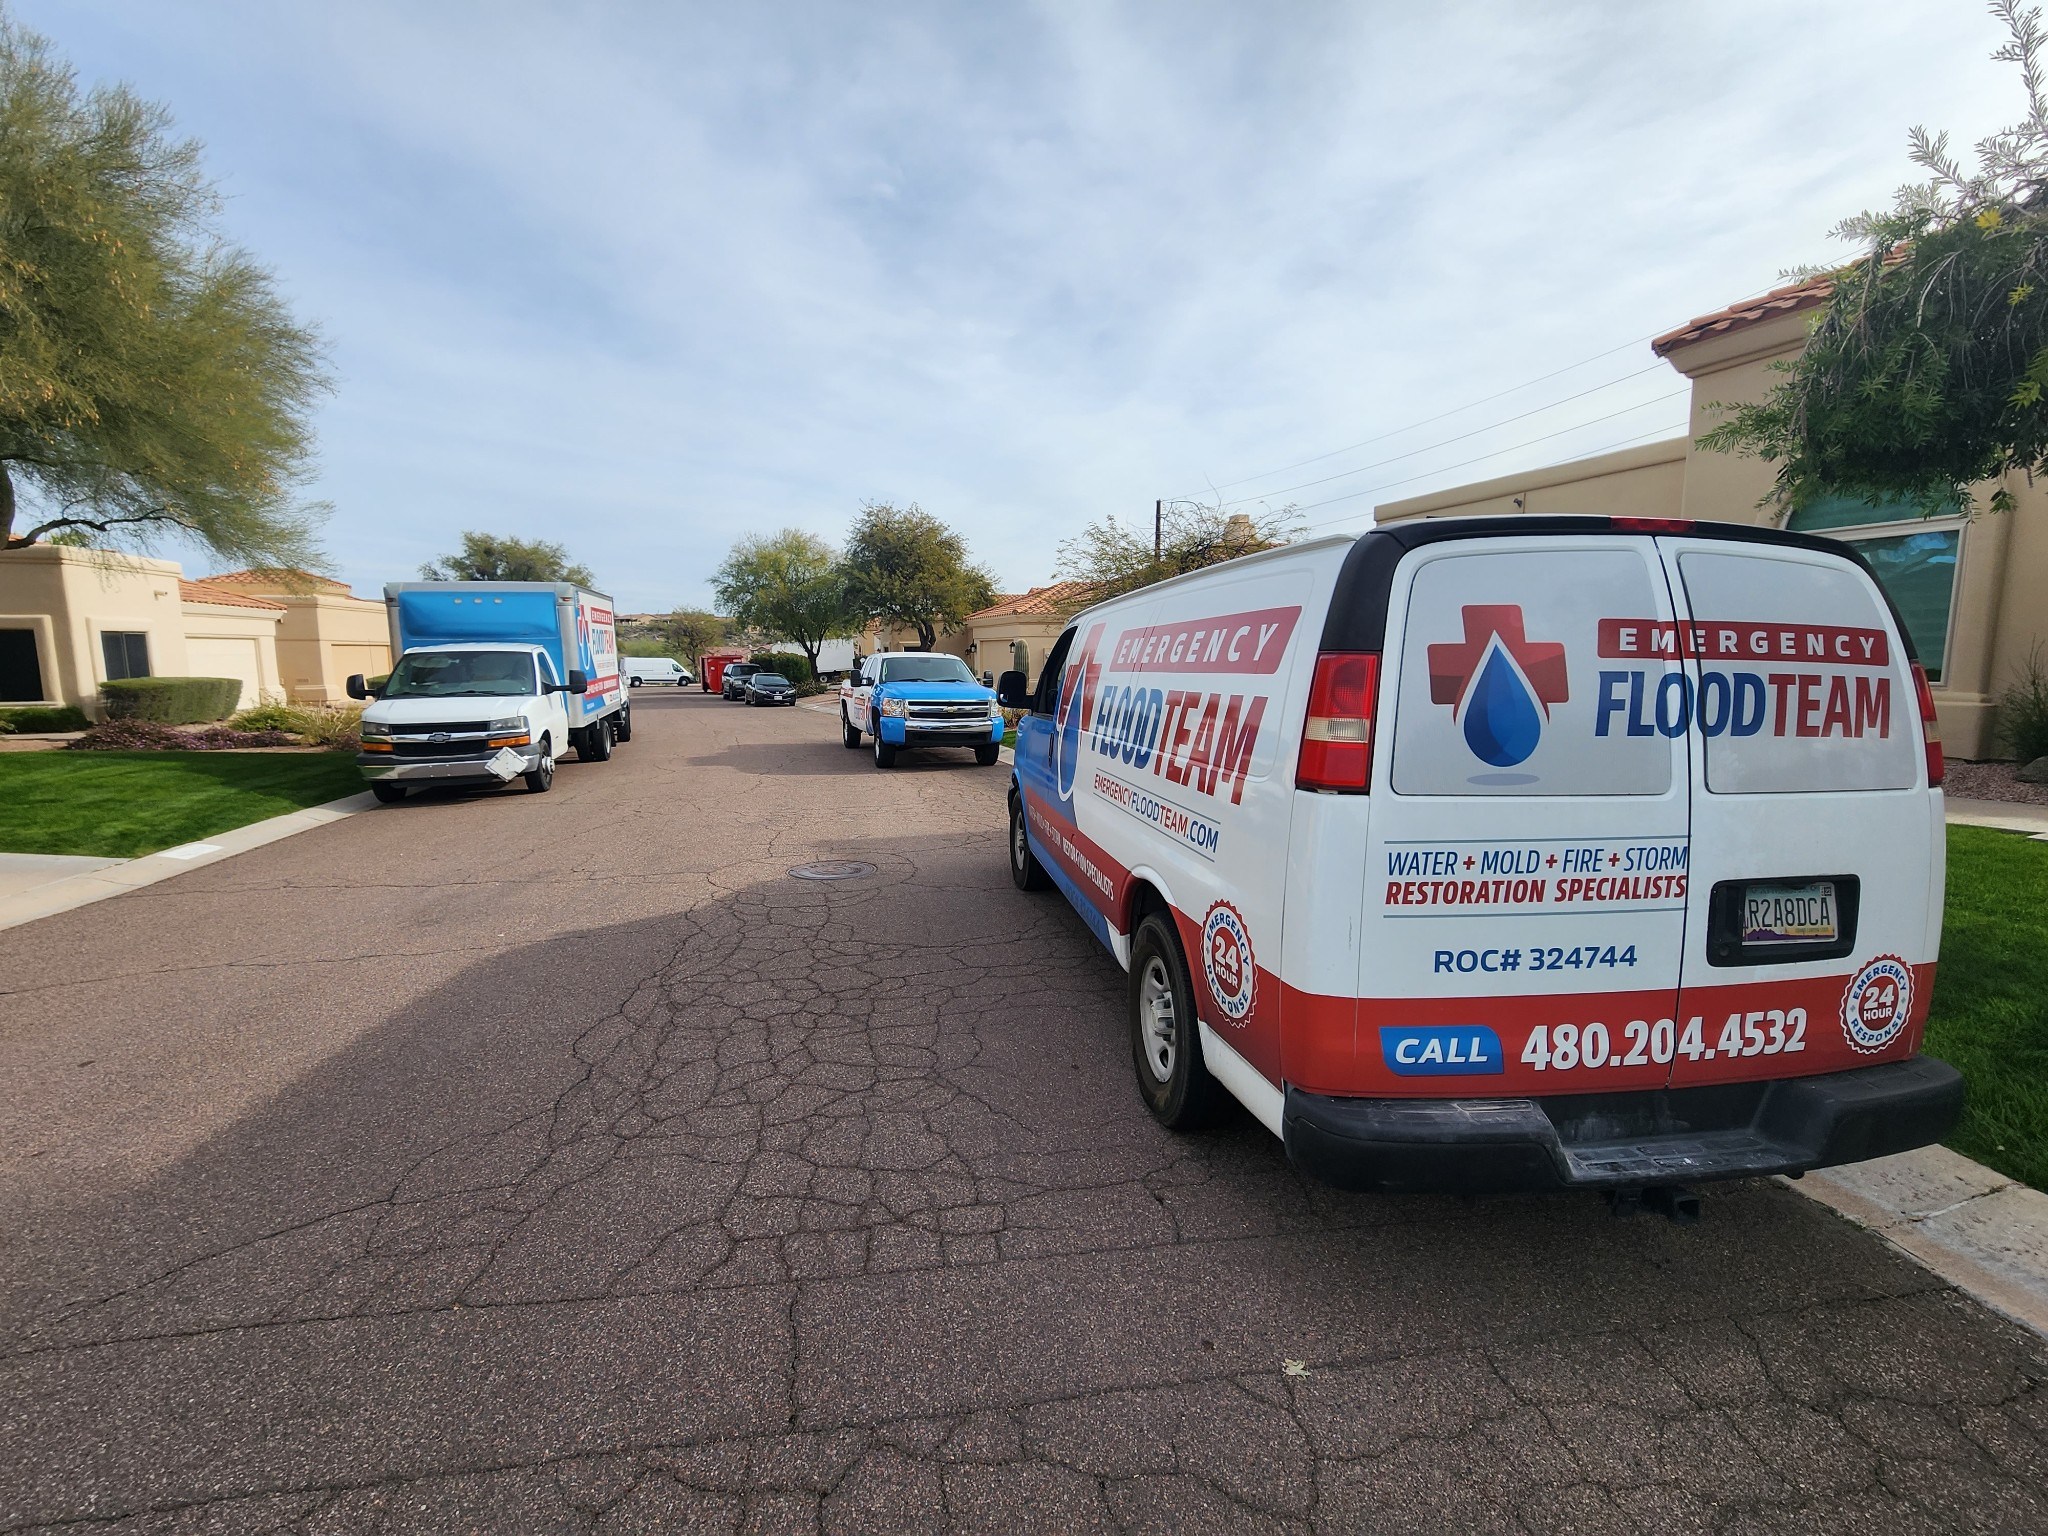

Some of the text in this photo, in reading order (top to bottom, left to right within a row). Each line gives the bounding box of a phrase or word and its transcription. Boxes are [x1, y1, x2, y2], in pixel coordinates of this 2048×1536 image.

[1117, 623, 1280, 664] EMERGENCY
[1618, 627, 1876, 659] EMERGENCY
[1595, 671, 1891, 739] FLOODTEAM
[1091, 685, 1269, 806] FLOODTEAM
[1094, 774, 1220, 853] EMERGENCYFLOODTEAM.COM
[1387, 851, 1459, 876] WATER
[1480, 849, 1541, 874] MOLD
[1562, 848, 1605, 872] FIRE
[1624, 846, 1689, 871] STORM
[1384, 874, 1688, 905] RESTORATION SPECIALISTS
[1748, 897, 1831, 928] R2A8DCA
[1206, 912, 1250, 966] EMERGENCY
[1215, 935, 1239, 974] 24
[1215, 962, 1239, 989] HOUR
[1434, 945, 1638, 973] ROC# 324744
[1206, 964, 1250, 1014] RESPONSE
[1852, 964, 1907, 1000] EMERGENCY
[1863, 984, 1895, 1010] 24
[1851, 1011, 1904, 1043] RESPONSE
[1863, 1007, 1893, 1021] HOUR
[1395, 1007, 1807, 1071] CALL 480.204.4532
